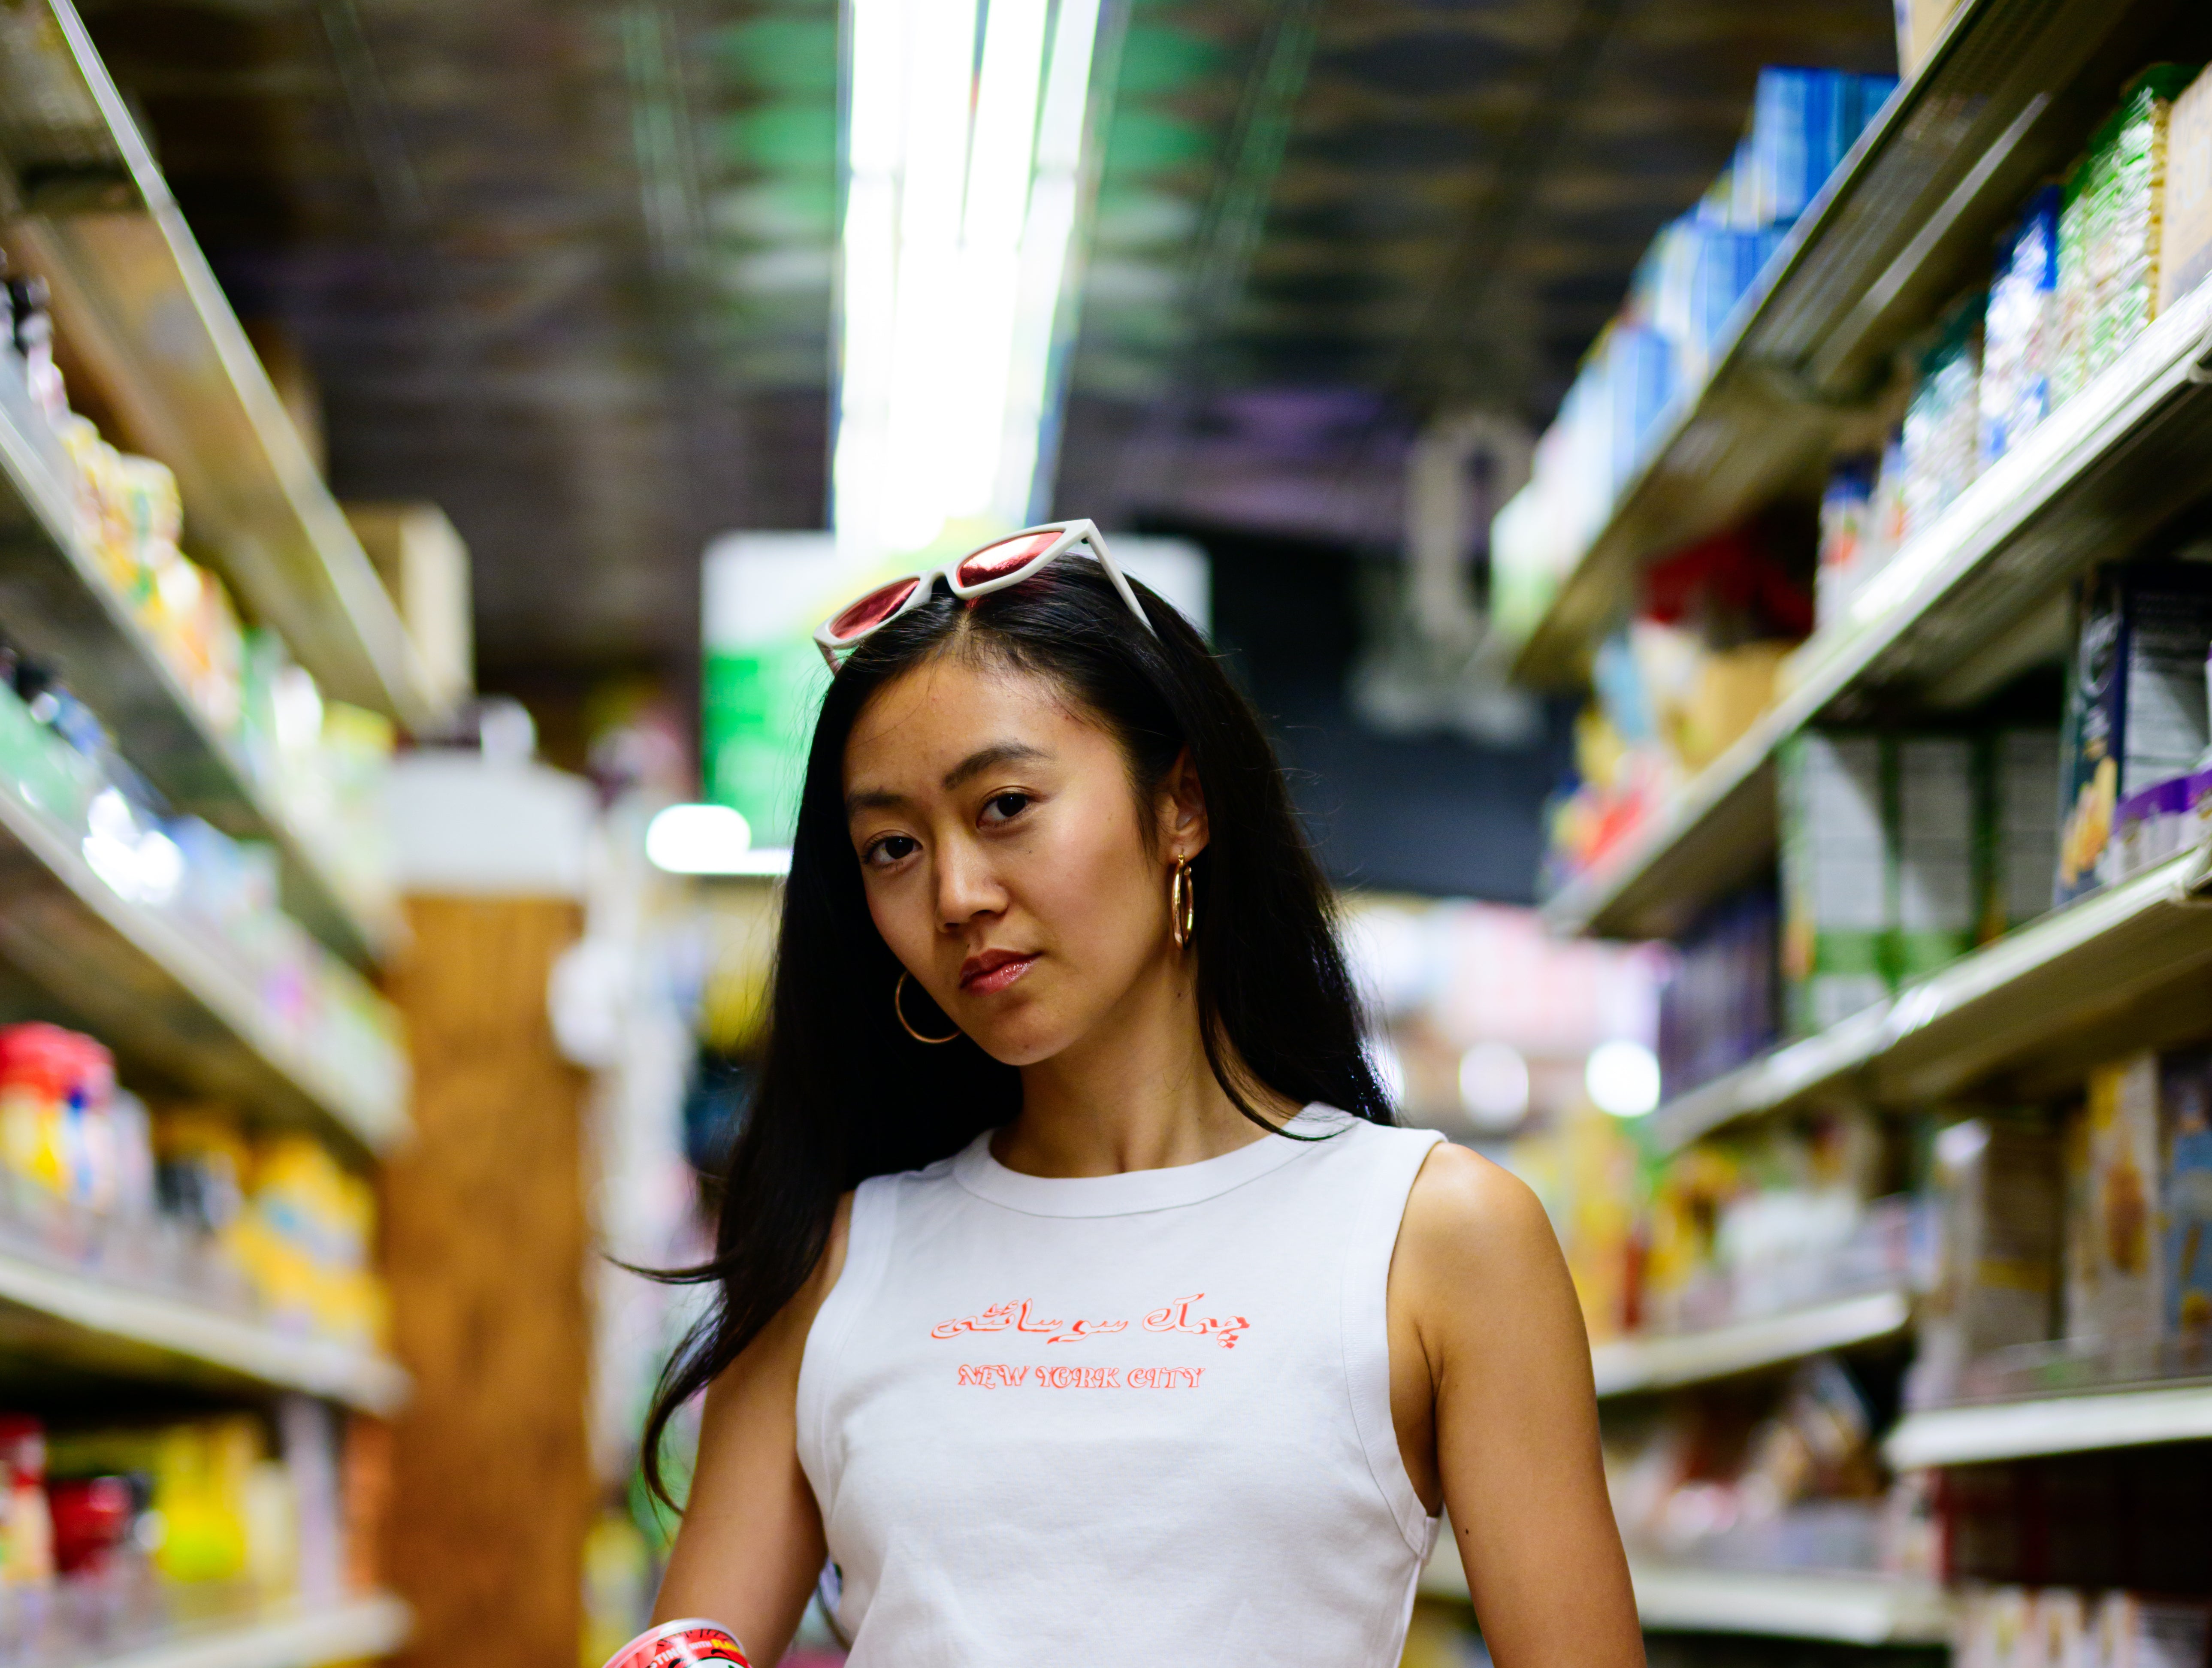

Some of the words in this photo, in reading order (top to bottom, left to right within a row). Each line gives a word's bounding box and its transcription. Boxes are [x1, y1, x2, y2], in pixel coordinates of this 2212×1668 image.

[1142, 1292, 1251, 1350] چمک
[958, 1363, 1030, 1390] NEW
[1035, 1366, 1121, 1390] YORK
[1126, 1366, 1206, 1389] CITY
[689, 1641, 712, 1650] WITH
